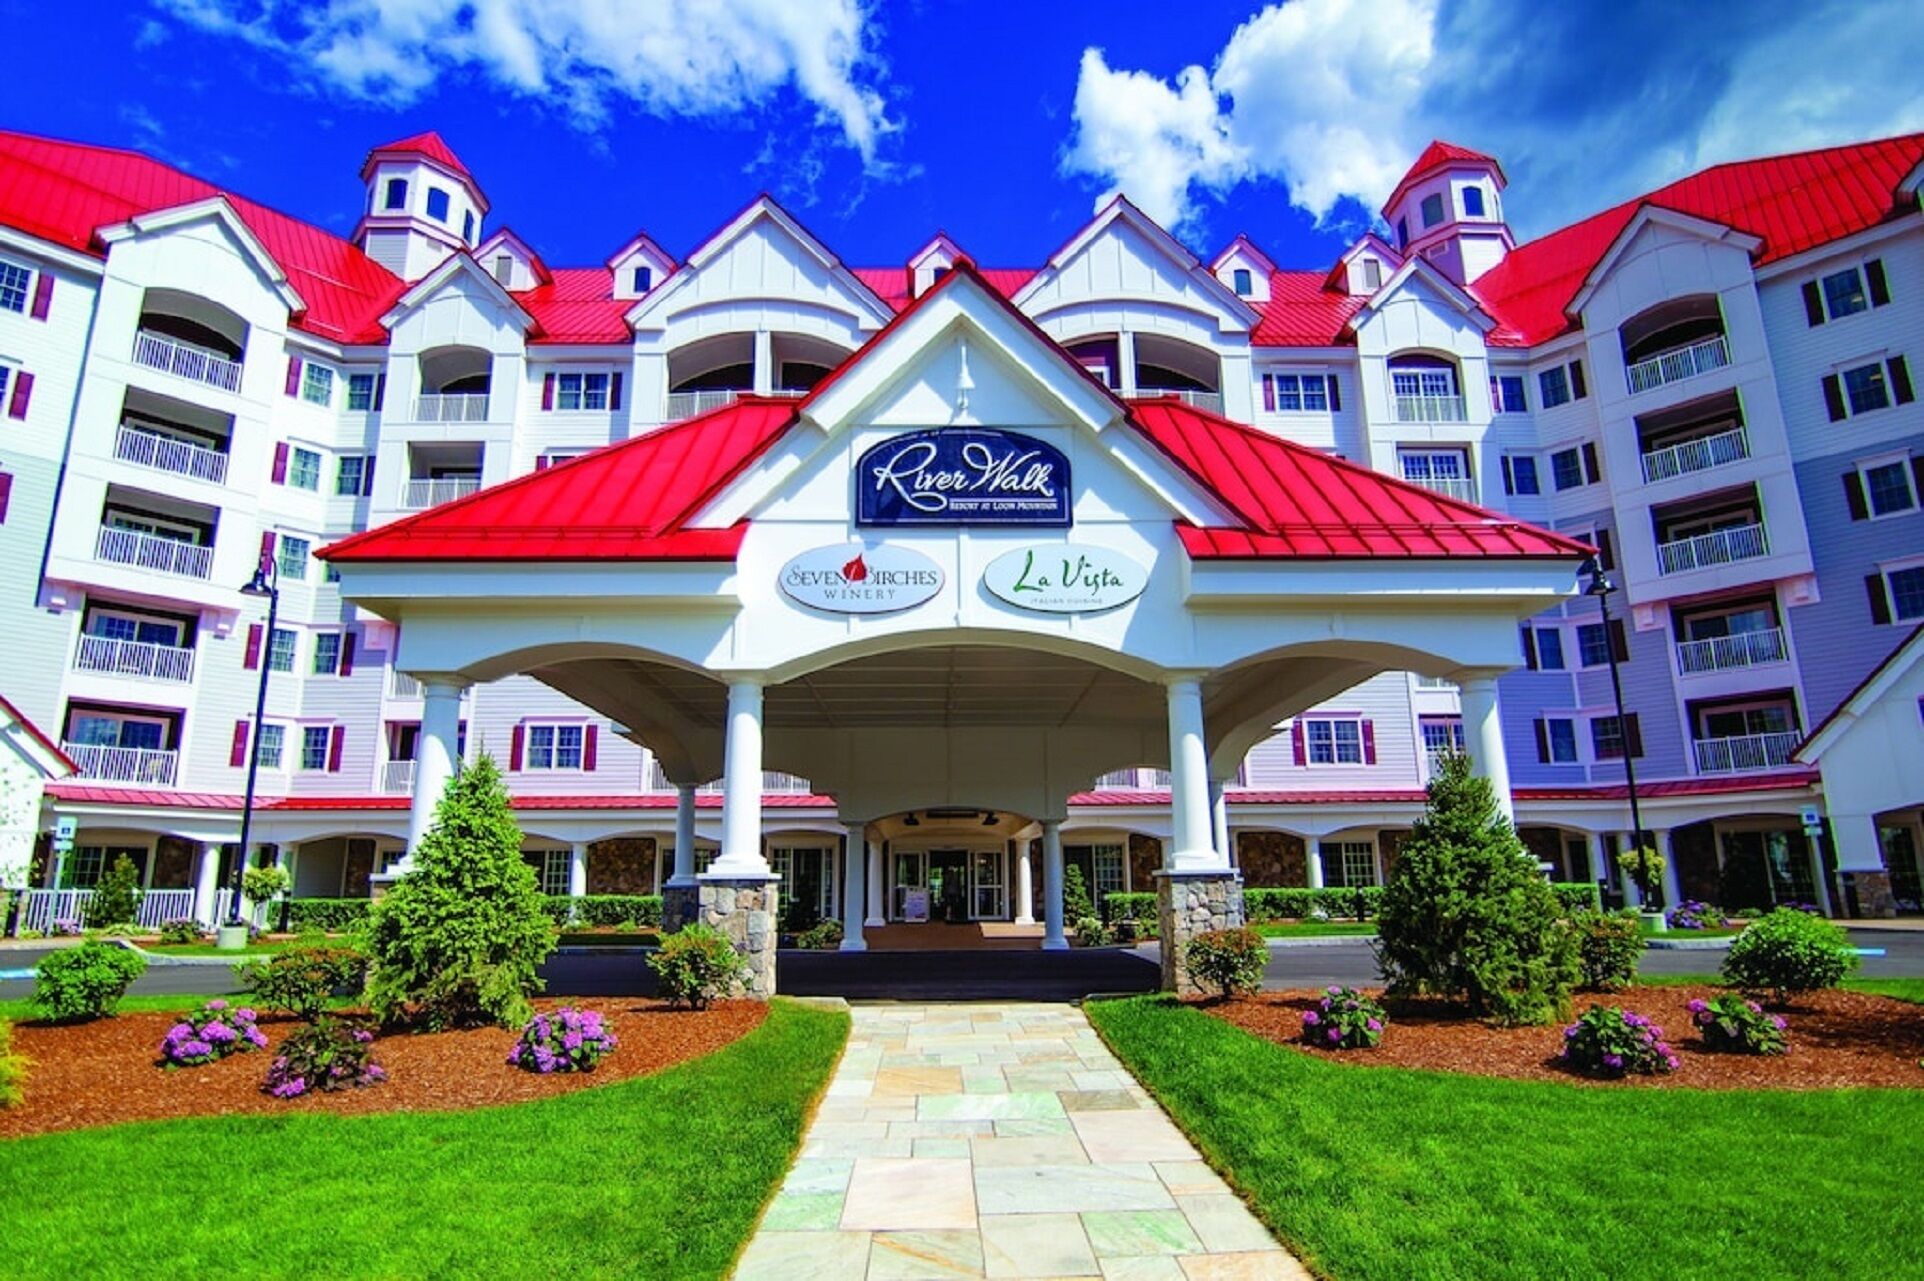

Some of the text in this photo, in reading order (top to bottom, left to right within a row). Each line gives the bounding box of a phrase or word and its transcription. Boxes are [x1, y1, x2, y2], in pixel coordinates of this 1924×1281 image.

[873, 442, 1054, 512] River Walk
[786, 564, 851, 588] SEVEN
[1013, 550, 1123, 596] La Vista
[824, 589, 896, 600] WINERY
